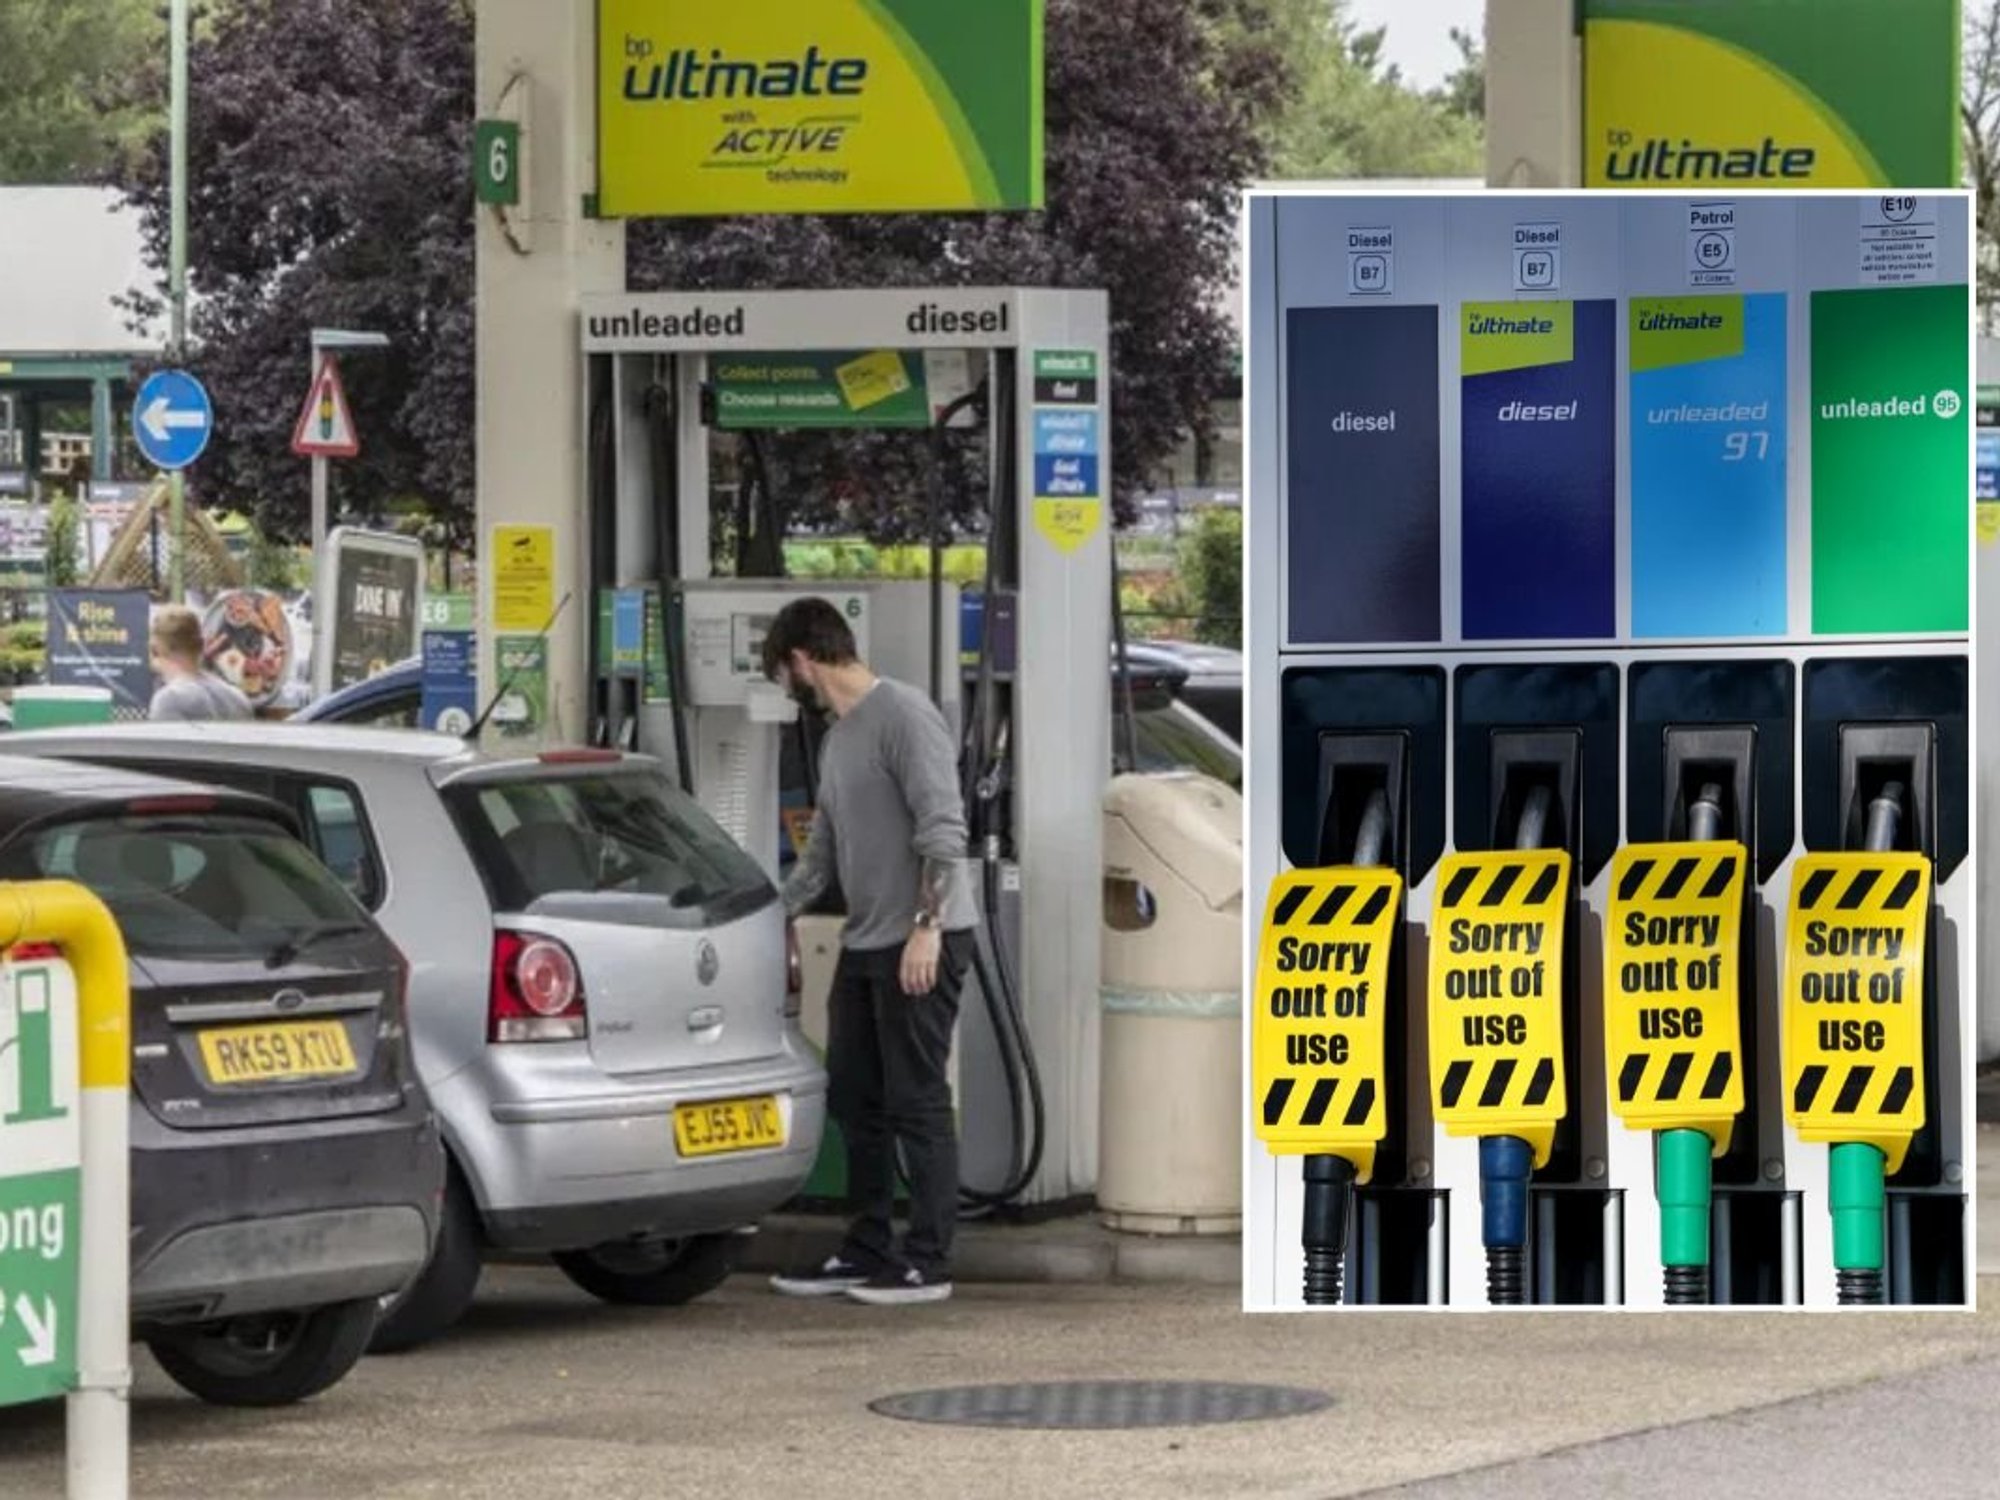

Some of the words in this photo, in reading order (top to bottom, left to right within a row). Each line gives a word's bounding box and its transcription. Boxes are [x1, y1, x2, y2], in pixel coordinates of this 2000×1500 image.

[624, 33, 653, 60] bp
[623, 46, 868, 100] ultimate
[721, 111, 756, 124] with
[712, 126, 846, 154] ACTIVE
[1606, 127, 1633, 149] bp
[489, 136, 508, 181] 6
[1605, 136, 1816, 181] ultimate
[766, 168, 849, 184] technology
[1690, 209, 1734, 225] Petrol
[1885, 196, 1913, 212] E10
[1349, 233, 1392, 248] Diesel
[1513, 228, 1559, 244] Diesel
[1702, 243, 1722, 258] E5
[1360, 265, 1380, 281] B7
[1527, 262, 1547, 277] B7
[589, 306, 745, 338] unleaded
[906, 302, 1009, 333] diesel
[1469, 316, 1554, 335] ultimate
[1639, 311, 1723, 331] ultimate
[1331, 409, 1396, 432] diesel
[1497, 400, 1578, 421] diesel
[1647, 402, 1768, 424] unleaded
[1820, 395, 1926, 419] unleaded
[1935, 391, 1959, 413] 95
[1721, 430, 1769, 461] 97
[845, 599, 862, 618] 6
[1450, 918, 1544, 955] Sorry
[1625, 911, 1720, 948] Sorry
[1805, 920, 1904, 960] Sorry
[1276, 936, 1371, 976] Sorry
[1445, 965, 1502, 1000] out
[1510, 961, 1545, 998] of
[1621, 957, 1678, 993] out
[1686, 953, 1722, 991] of
[1801, 967, 1861, 1004] out
[1868, 967, 1904, 1004] of
[1270, 983, 1328, 1019] out
[1334, 981, 1369, 1018] of
[1463, 1013, 1527, 1047] use
[1639, 1006, 1703, 1039] use
[1818, 1019, 1885, 1051] use
[215, 1033, 293, 1077] RK59
[292, 1029, 345, 1070] XTU
[1286, 1033, 1349, 1066] use
[682, 1105, 739, 1146] EJ55
